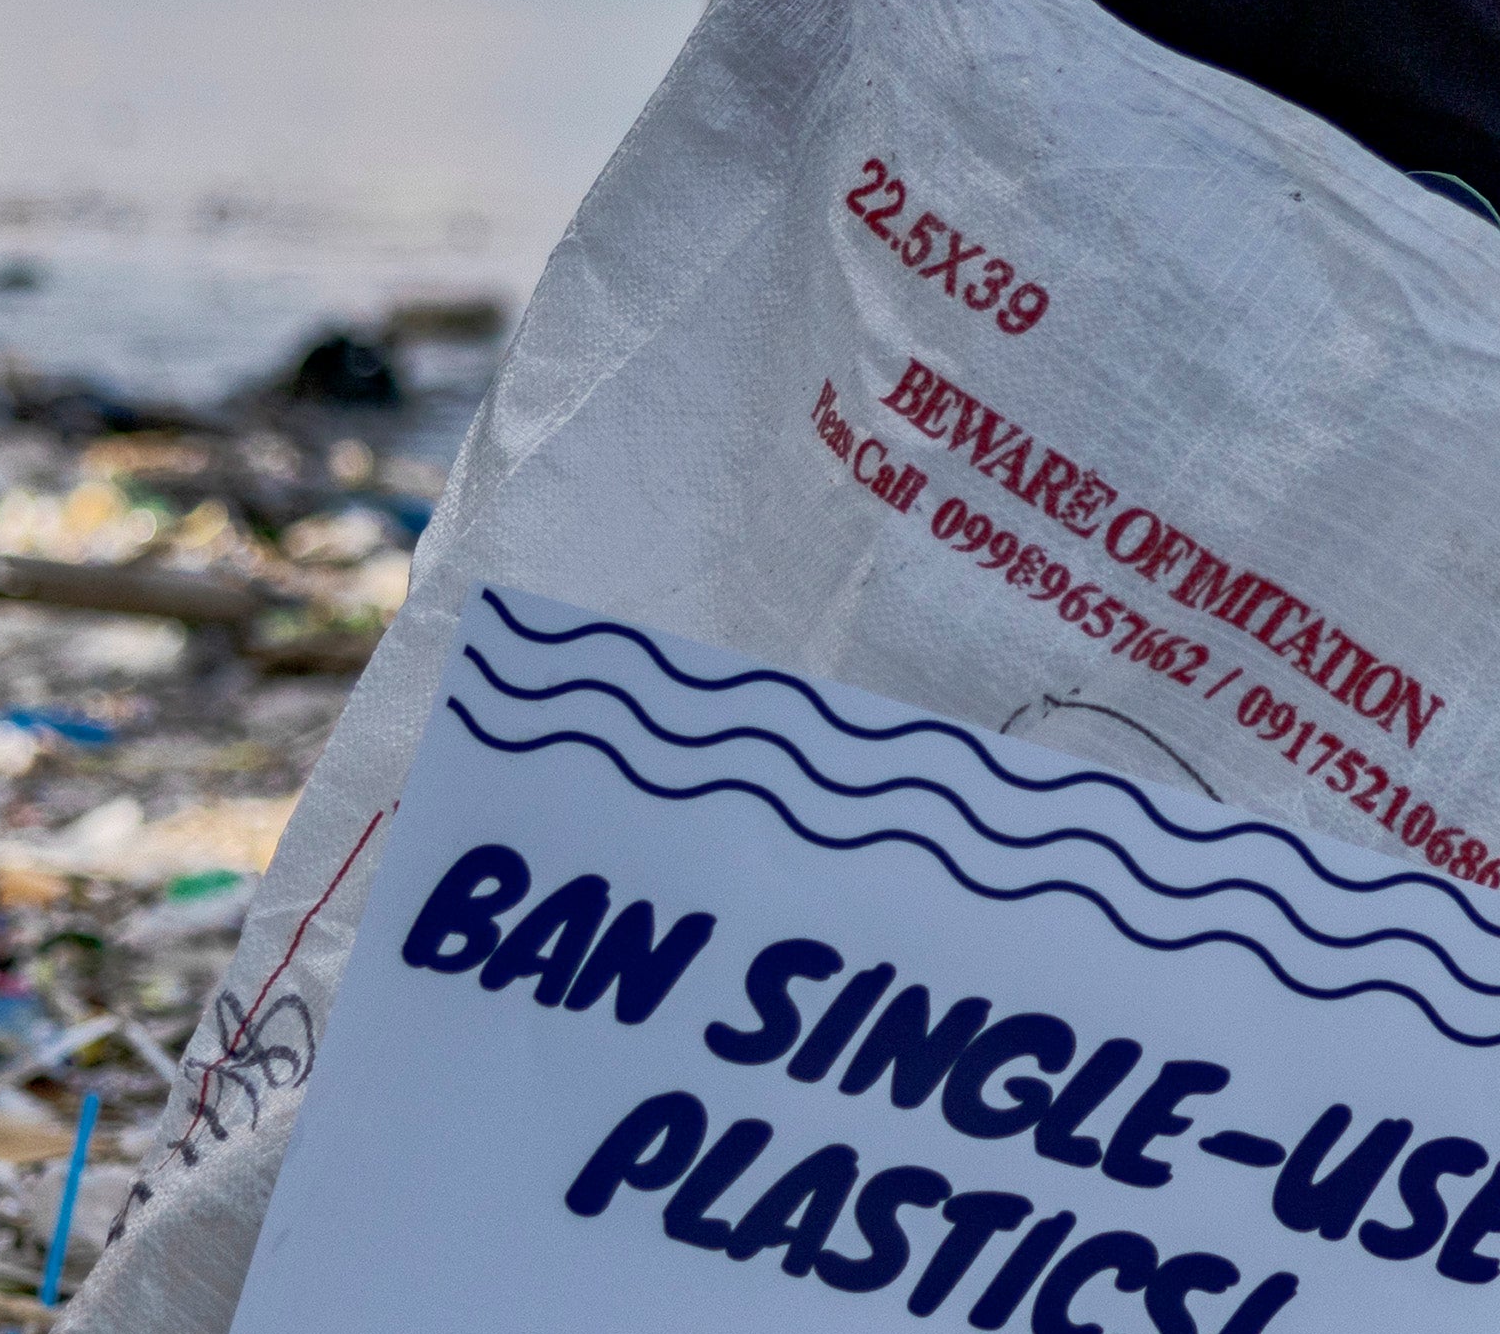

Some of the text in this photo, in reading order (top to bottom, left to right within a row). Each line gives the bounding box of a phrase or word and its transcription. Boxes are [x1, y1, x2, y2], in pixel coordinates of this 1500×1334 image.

[845, 157, 1050, 336] 22.5X39
[853, 437, 929, 515] Call
[930, 496, 1212, 688] 09989657662
[879, 356, 1446, 749] BEWARE OF IMITATION
[401, 842, 716, 1025] BAN
